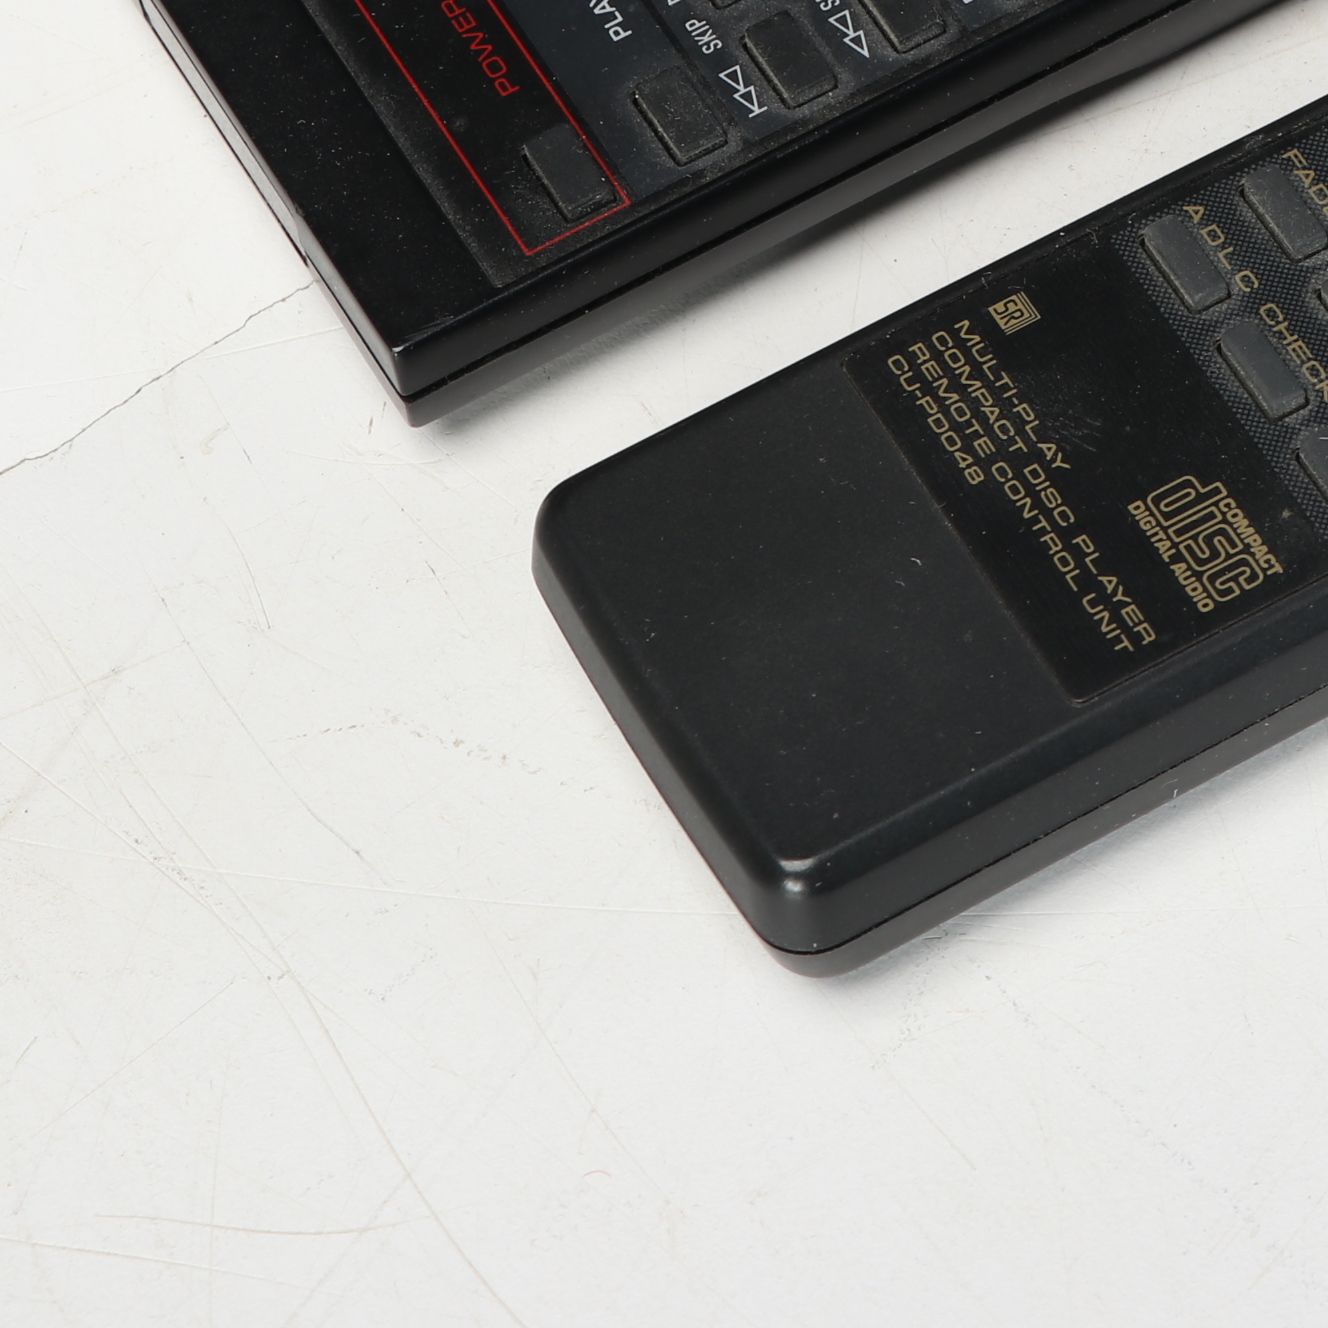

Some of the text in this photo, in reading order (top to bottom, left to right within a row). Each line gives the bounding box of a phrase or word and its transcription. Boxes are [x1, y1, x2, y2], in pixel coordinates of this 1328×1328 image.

[685, 19, 723, 55] SKIP
[995, 297, 1023, 329] SR
[887, 355, 985, 485] CU-PD048
[954, 319, 1071, 471] MULTI-PLAY
[908, 342, 1135, 653] REMOTE CONTROL UNIT
[932, 331, 1158, 646] COMPACT DISC PLAYER
[1218, 498, 1284, 578] COMPACT
[1127, 500, 1216, 613] DIGITAL AUDIO
